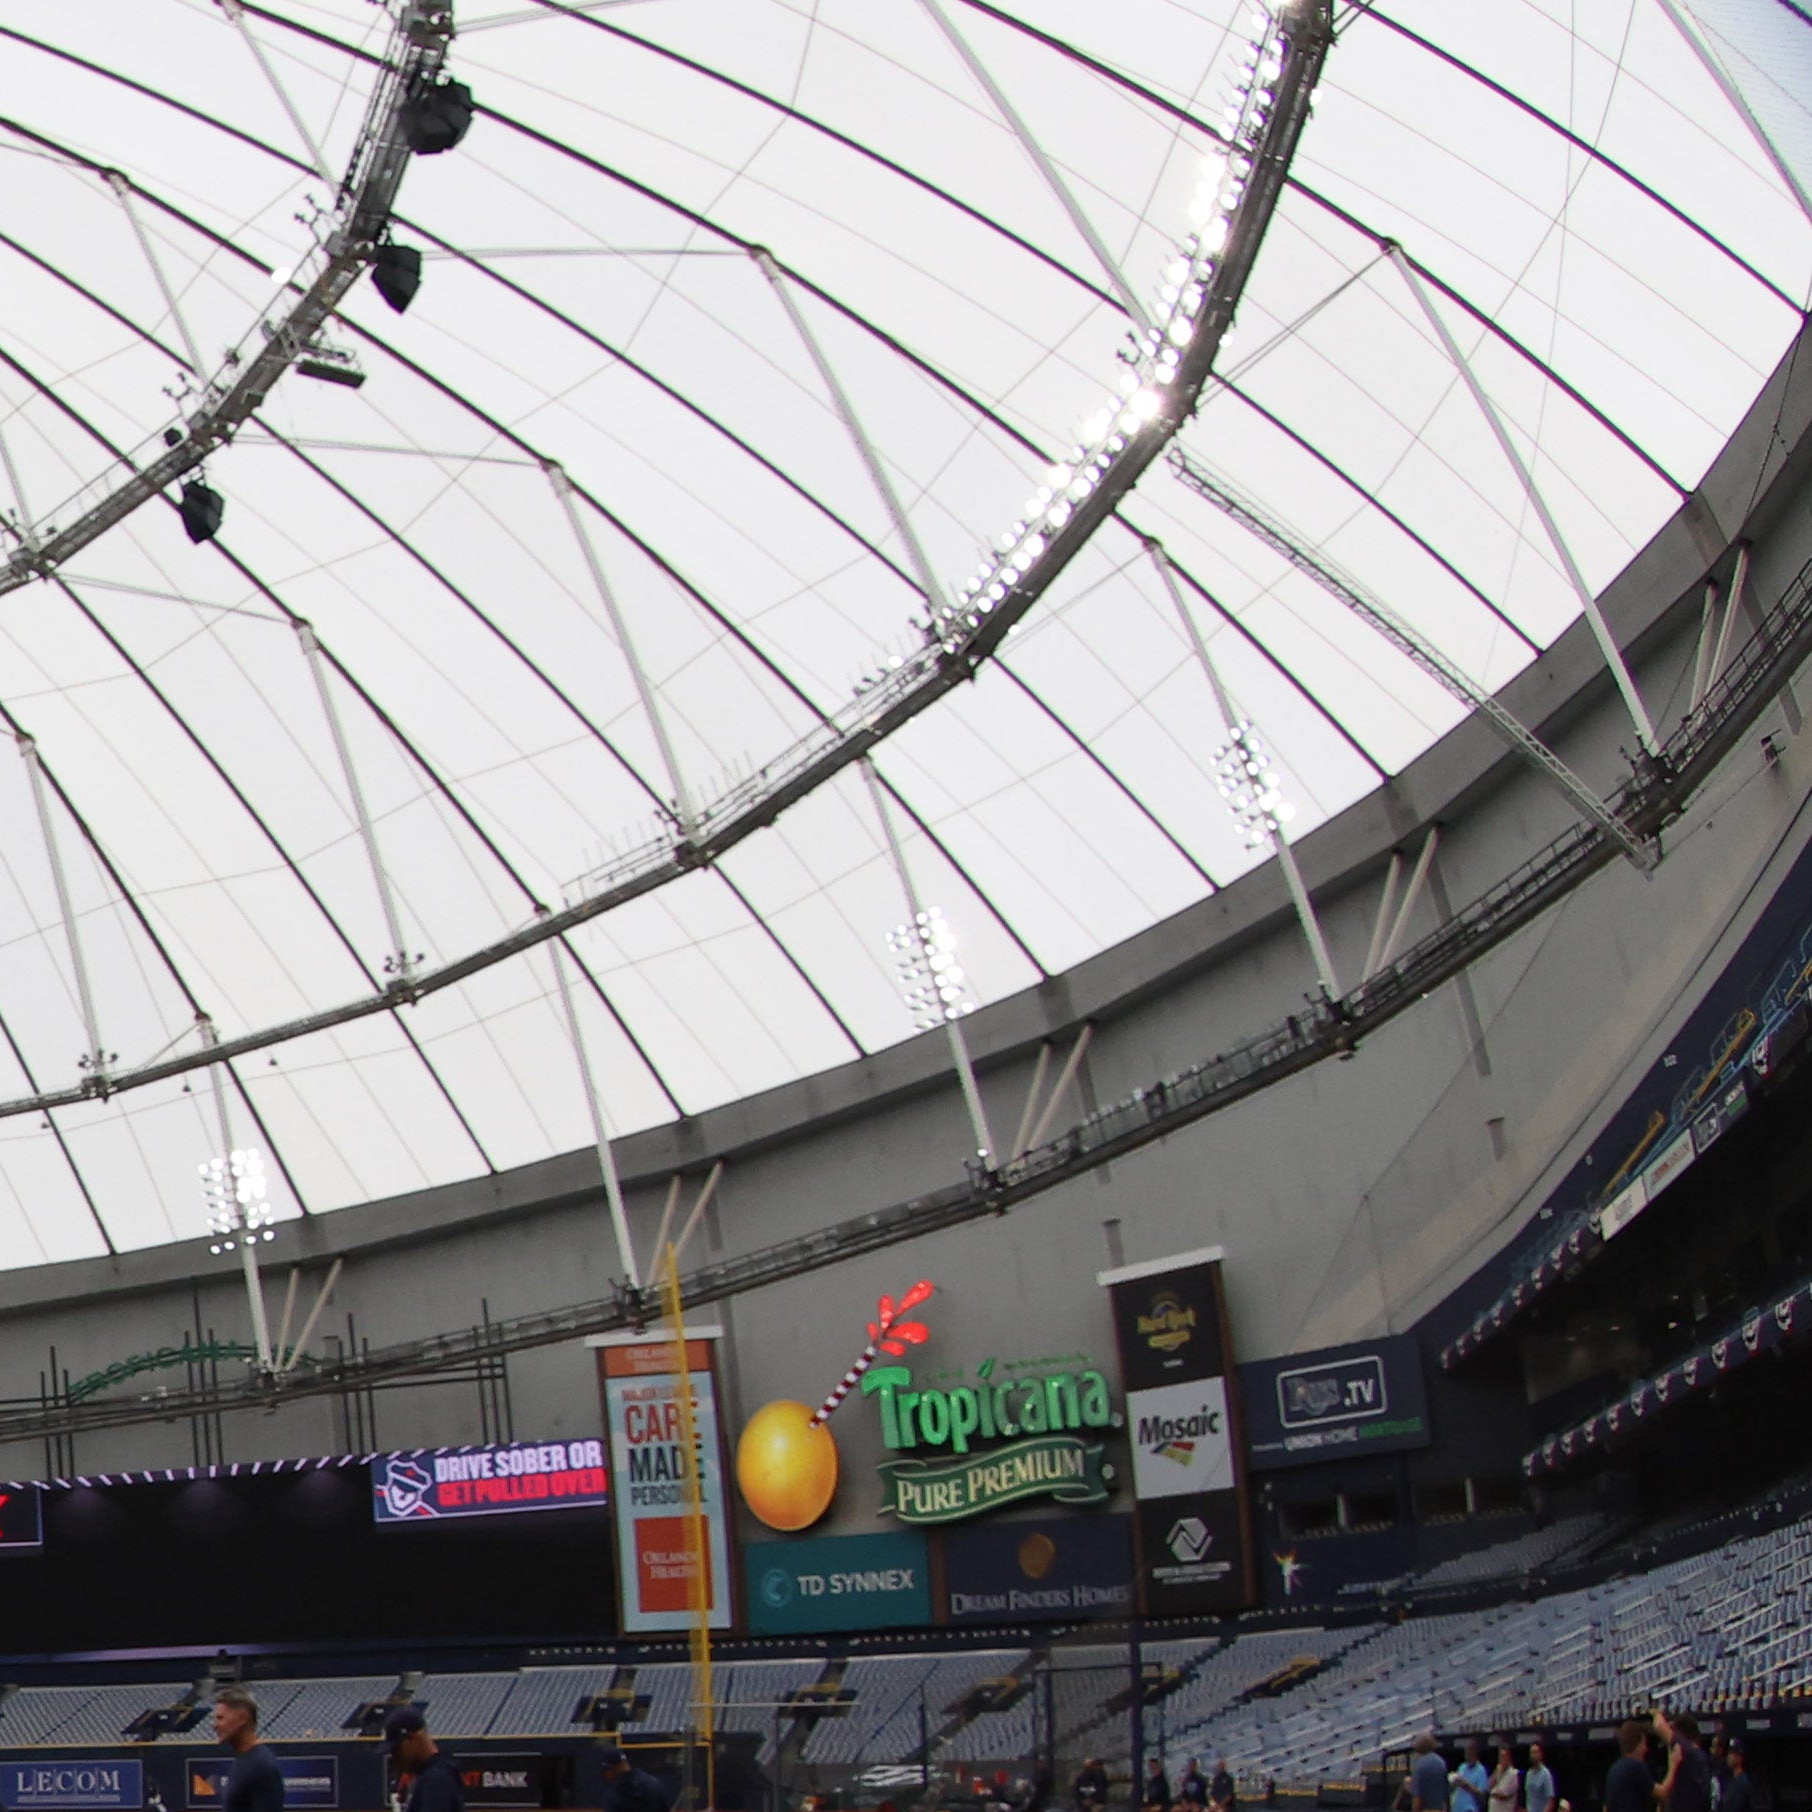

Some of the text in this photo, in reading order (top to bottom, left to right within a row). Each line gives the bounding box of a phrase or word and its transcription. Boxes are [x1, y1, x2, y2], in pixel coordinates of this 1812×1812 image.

[625, 1403, 702, 1445] CAR
[861, 1357, 1112, 1455] Tropicana
[1138, 1404, 1220, 1445] Mosaic
[434, 1440, 604, 1483] DRIVE SOBER OR
[896, 1446, 1086, 1514] PURE PREMIUM
[436, 1467, 607, 1507] GET PULLED OVER
[797, 1569, 915, 1596] TD SYNNEX
[950, 1583, 1130, 1616] DREAM FINDERS HOMES
[17, 1770, 121, 1793] LECOM
[482, 1770, 528, 1788] BANK
